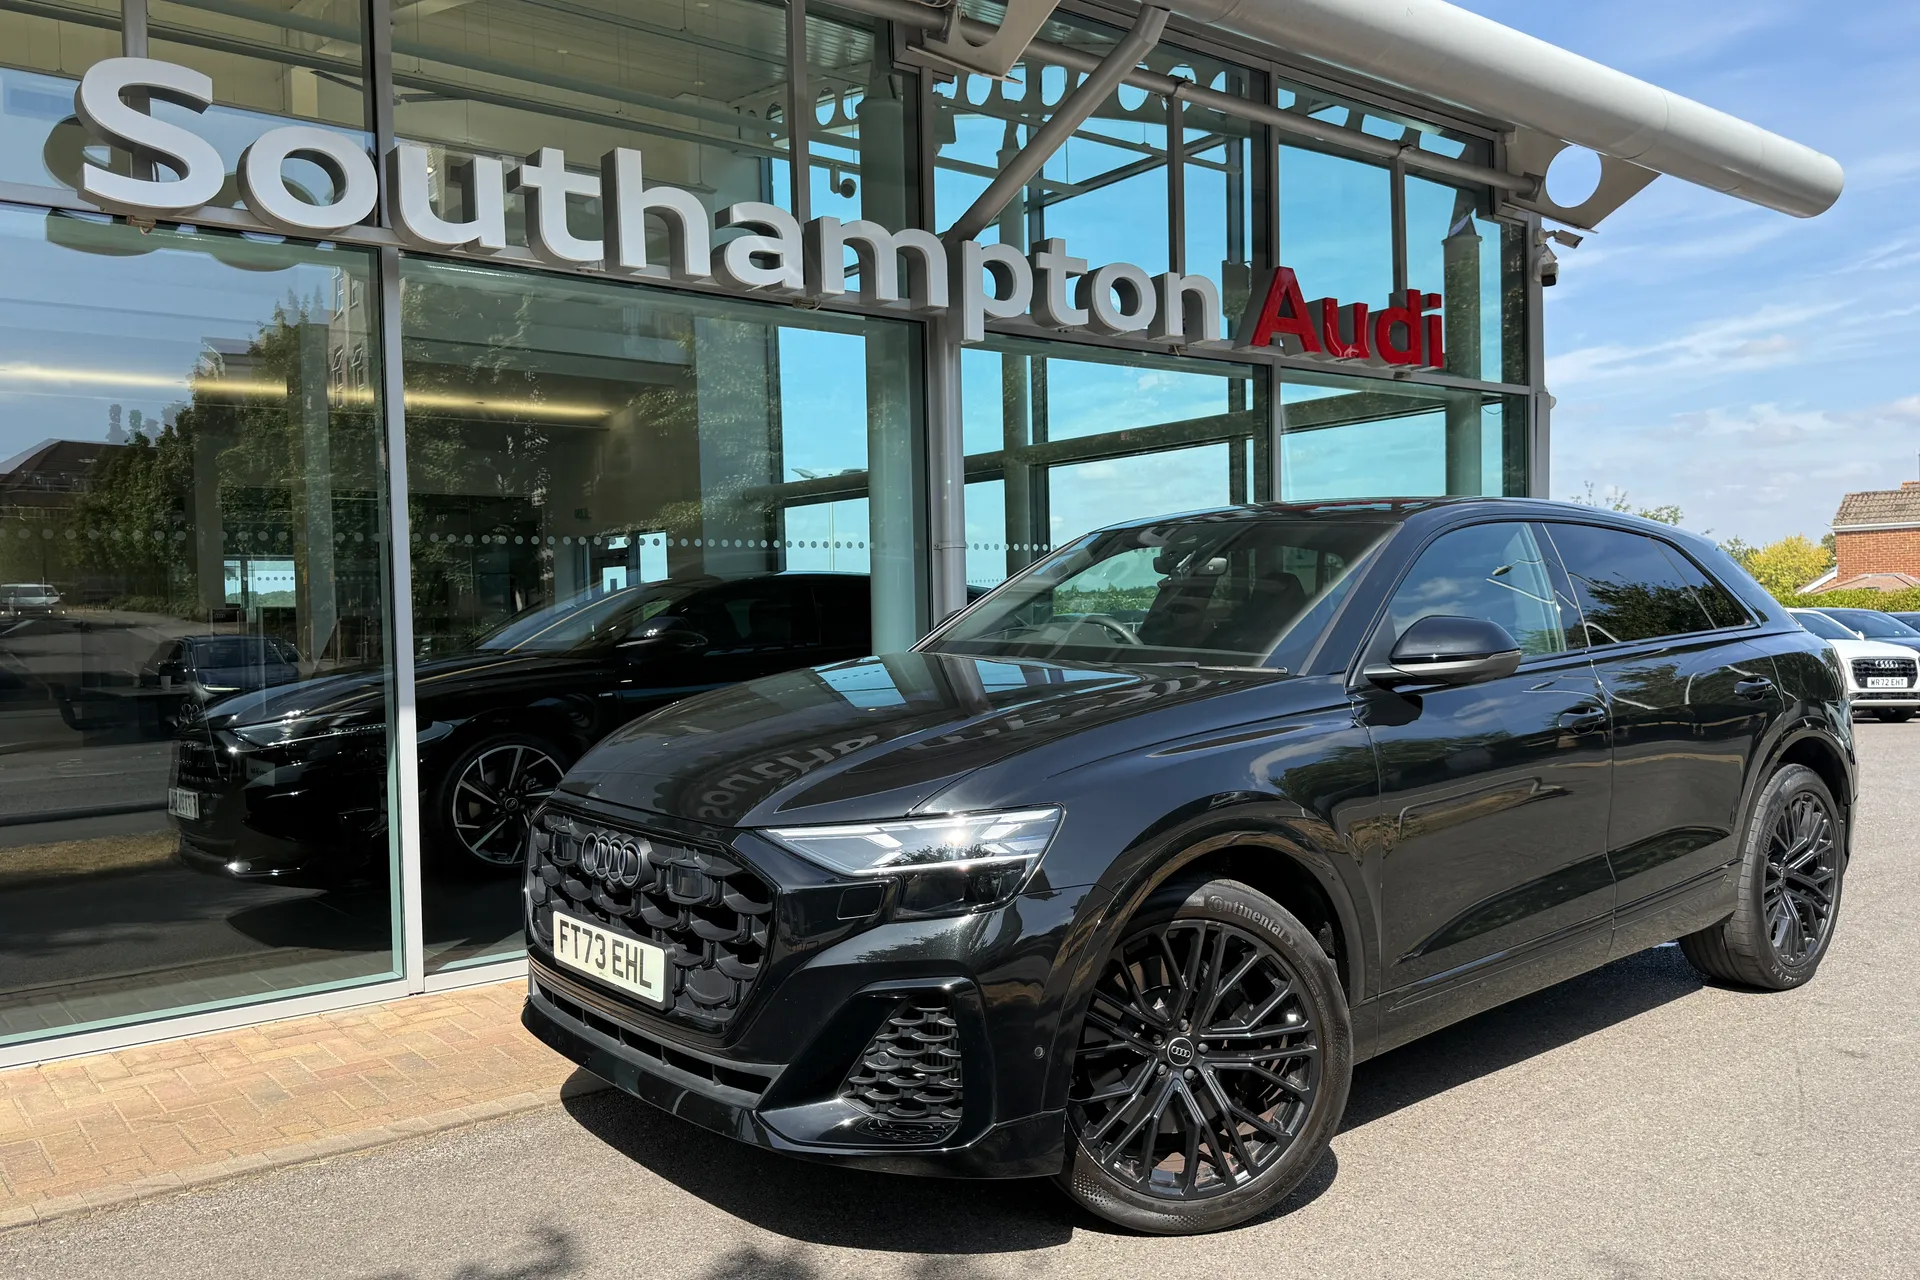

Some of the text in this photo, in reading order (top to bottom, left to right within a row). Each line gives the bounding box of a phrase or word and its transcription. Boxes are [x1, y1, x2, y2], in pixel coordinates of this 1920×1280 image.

[74, 57, 1444, 371] Southampton Audi
[1208, 895, 1284, 938] Continental
[560, 919, 652, 989] FT73 EHL
